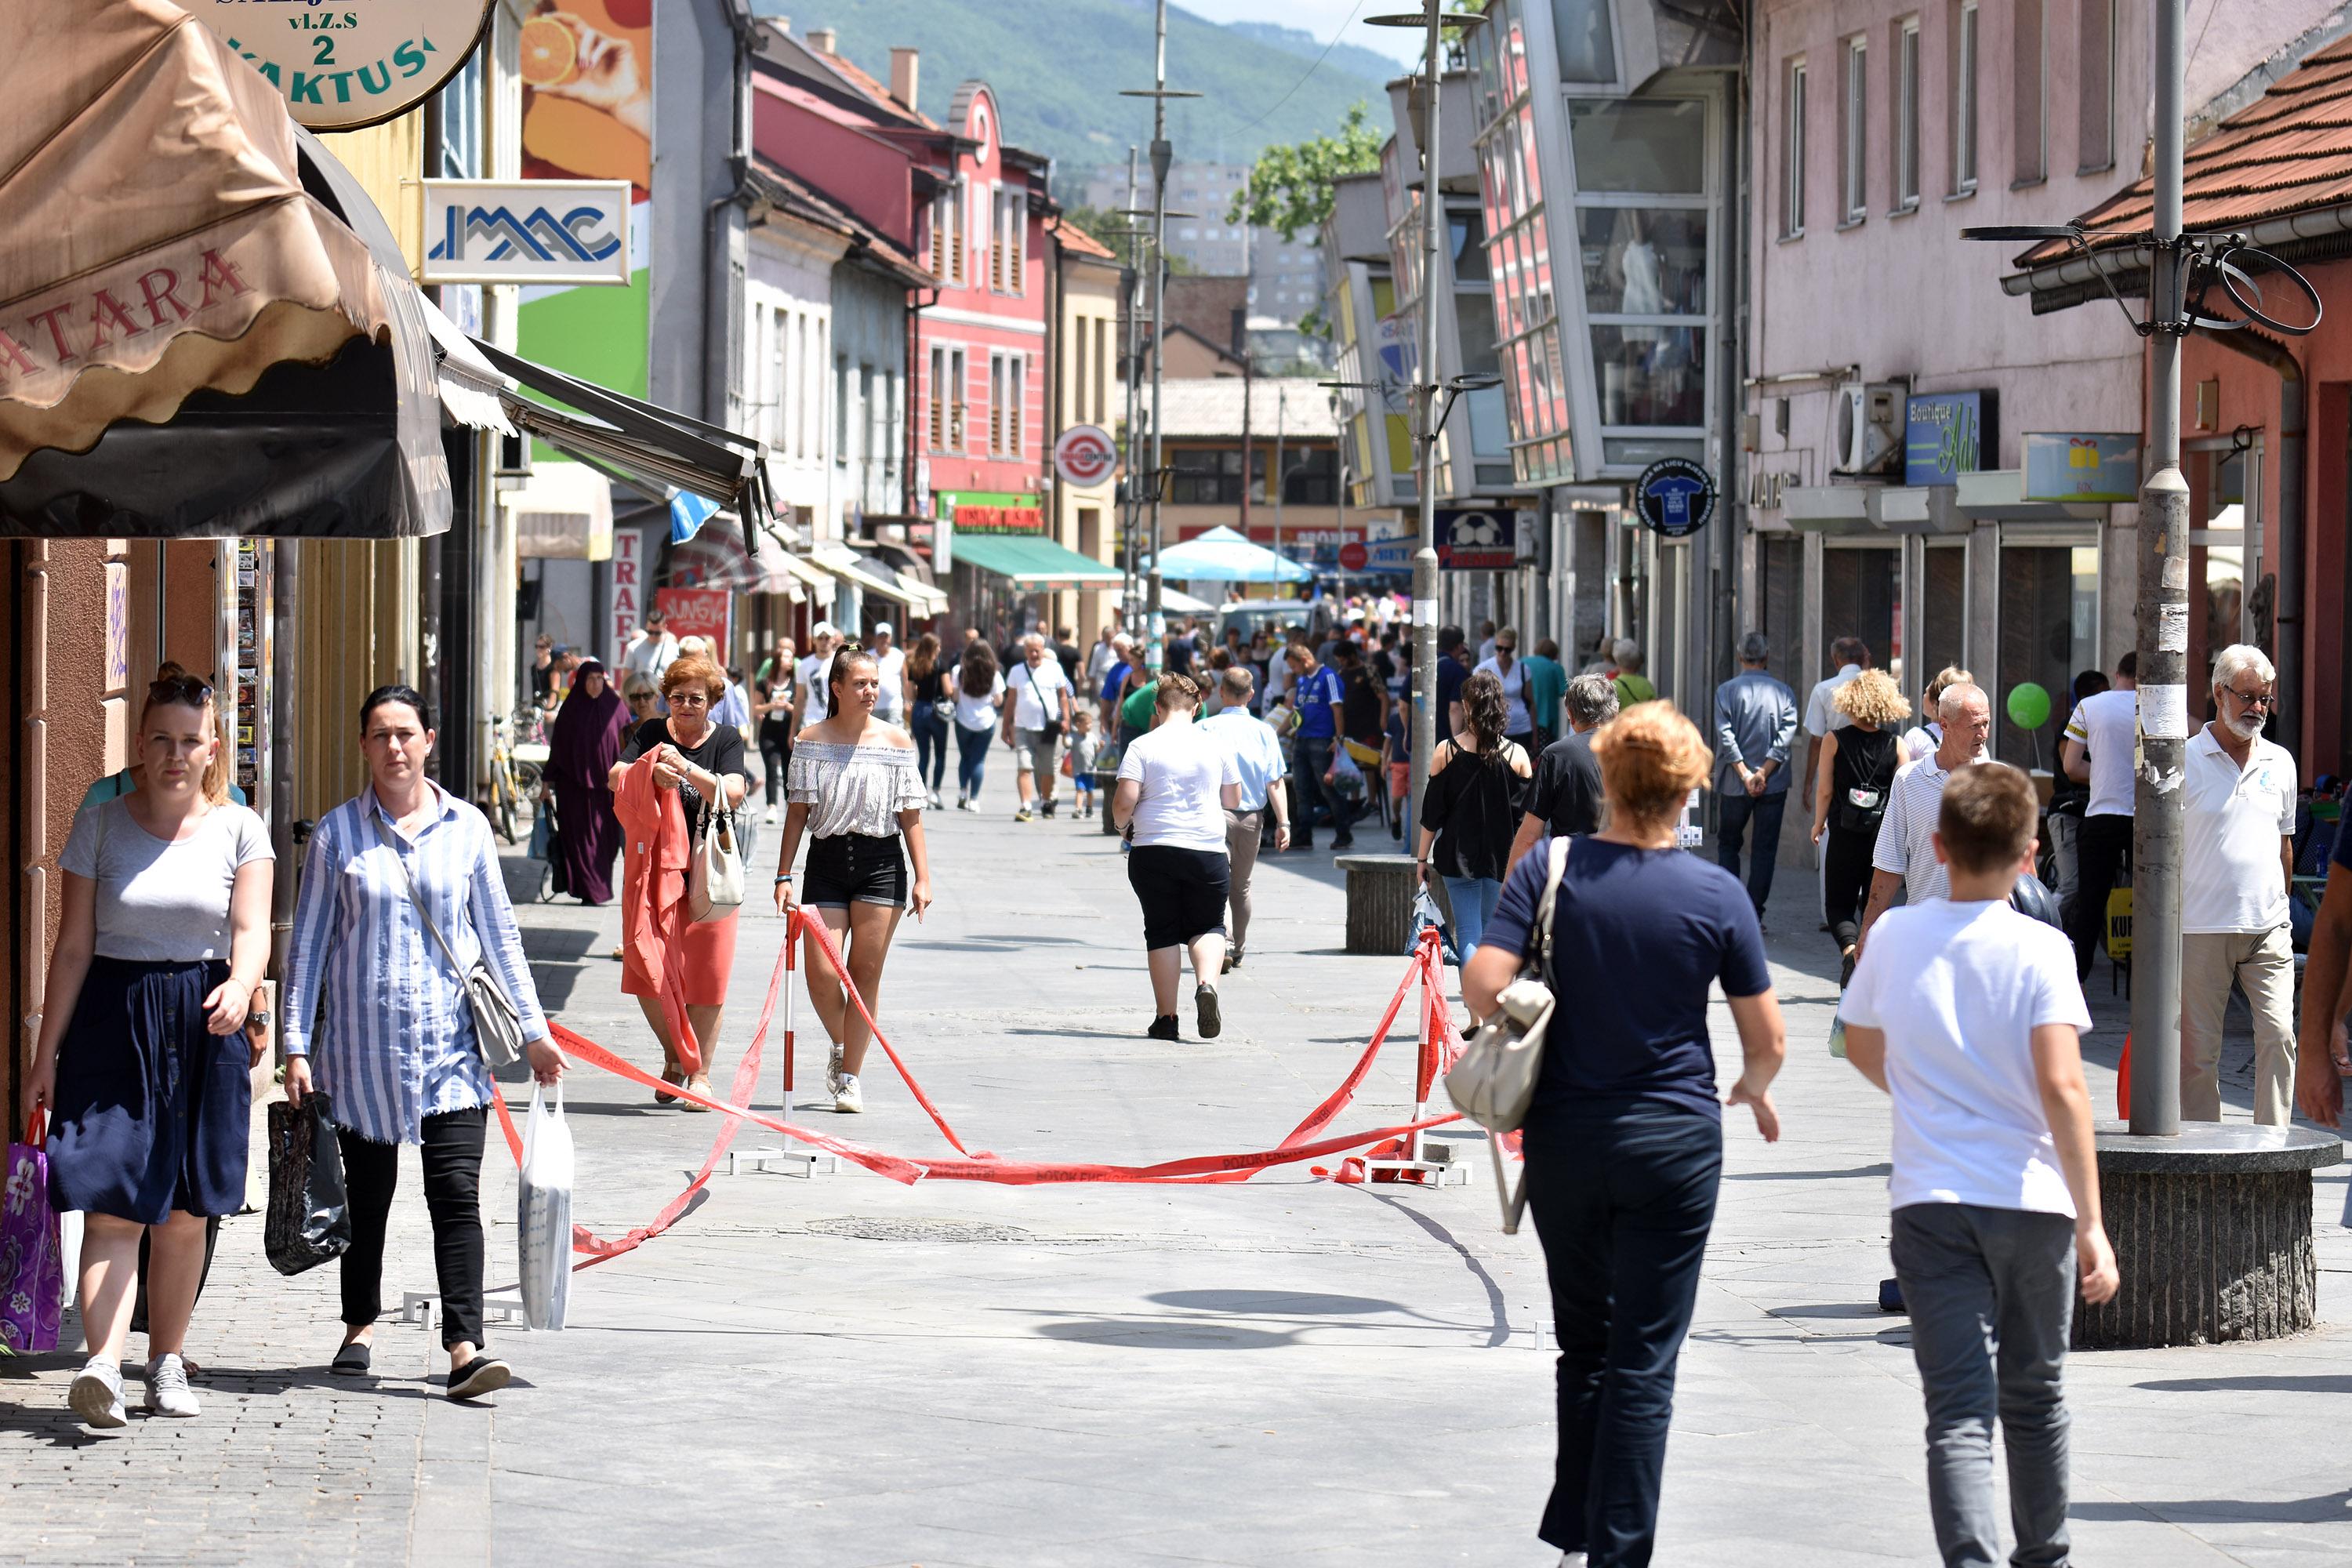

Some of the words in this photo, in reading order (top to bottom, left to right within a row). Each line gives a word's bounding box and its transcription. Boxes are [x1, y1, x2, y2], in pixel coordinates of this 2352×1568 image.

[312, 35, 336, 65] 2
[428, 205, 621, 261] IMAC
[1938, 401, 1977, 475] Adi
[1652, 463, 1664, 473] NA
